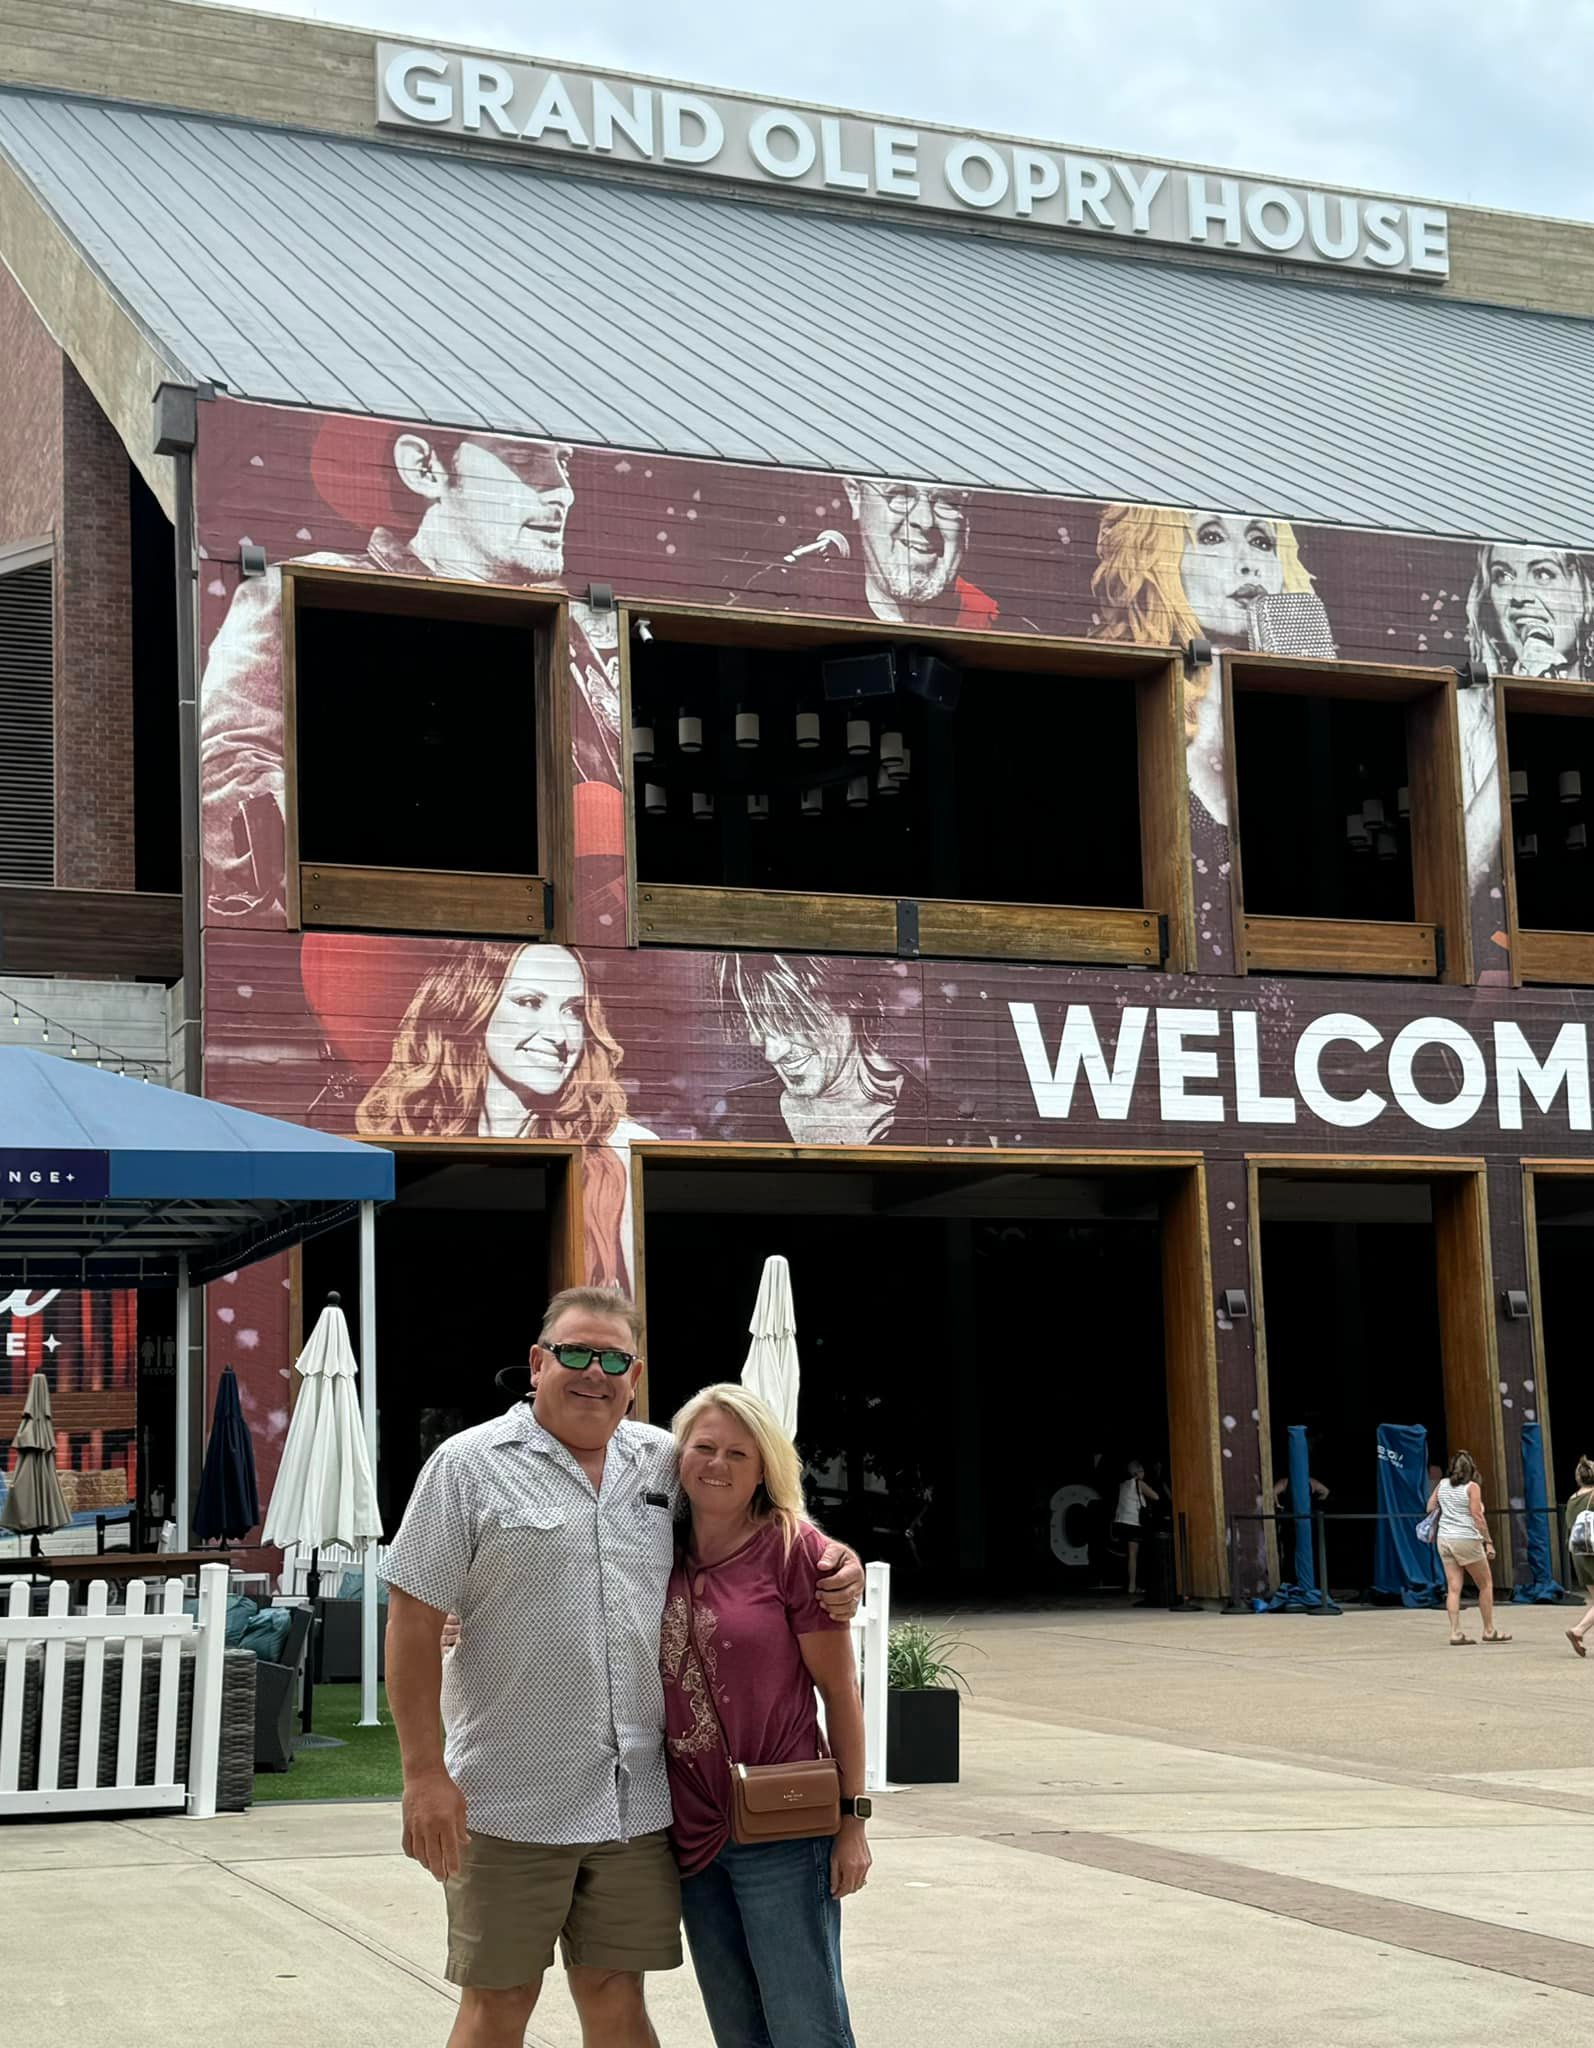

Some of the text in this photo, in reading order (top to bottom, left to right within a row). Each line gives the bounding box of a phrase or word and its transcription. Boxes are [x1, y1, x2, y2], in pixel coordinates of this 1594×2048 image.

[384, 50, 1449, 275] GRAND OLE OPRY HOUSE
[1008, 1001, 1592, 1130] WELCOM
